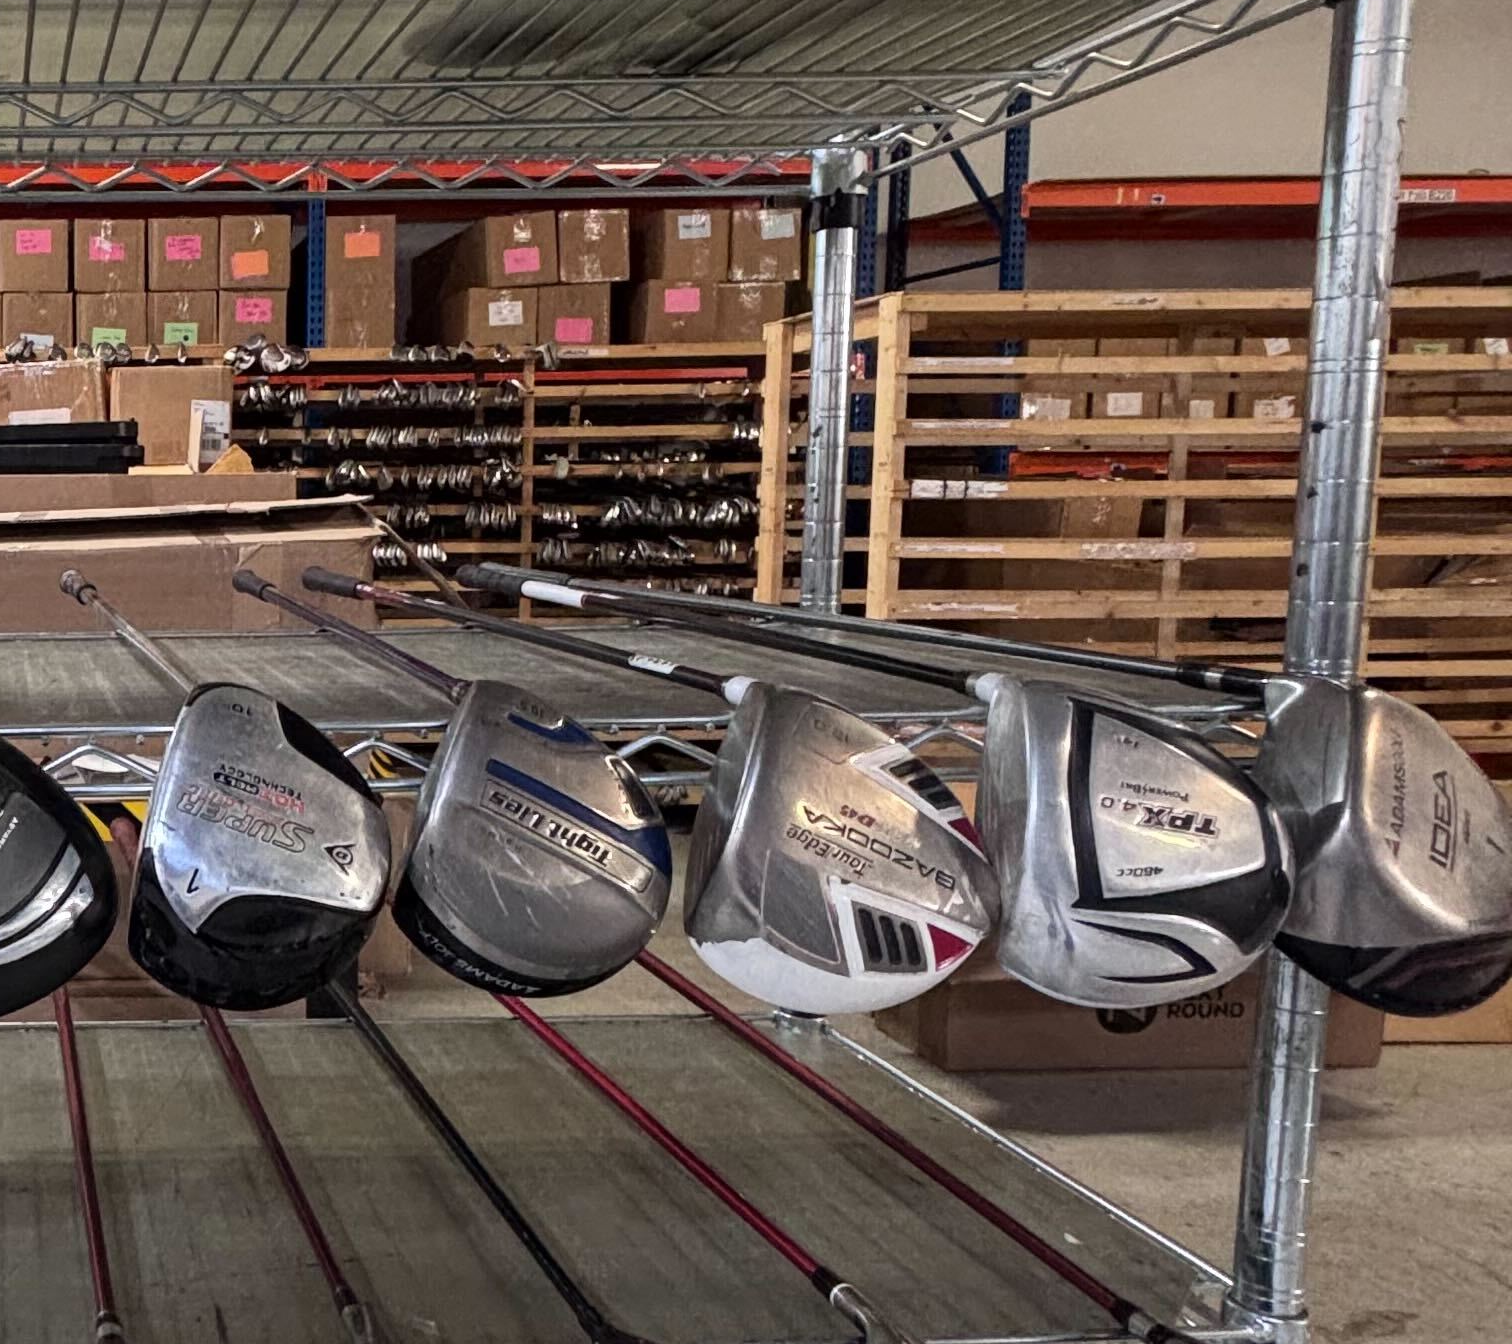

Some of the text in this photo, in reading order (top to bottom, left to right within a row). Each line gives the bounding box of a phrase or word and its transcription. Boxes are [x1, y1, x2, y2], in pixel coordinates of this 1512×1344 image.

[219, 762, 303, 801] TECHNOLOGY
[1389, 764, 1408, 838] ADAMS
[175, 790, 316, 854] SUPER
[546, 819, 610, 869] Tight
[1100, 795, 1221, 840] TPX 4.0
[1430, 769, 1454, 869] IDEA
[801, 804, 957, 891] BAZOOKA
[1167, 1001, 1245, 1019] ROUND
